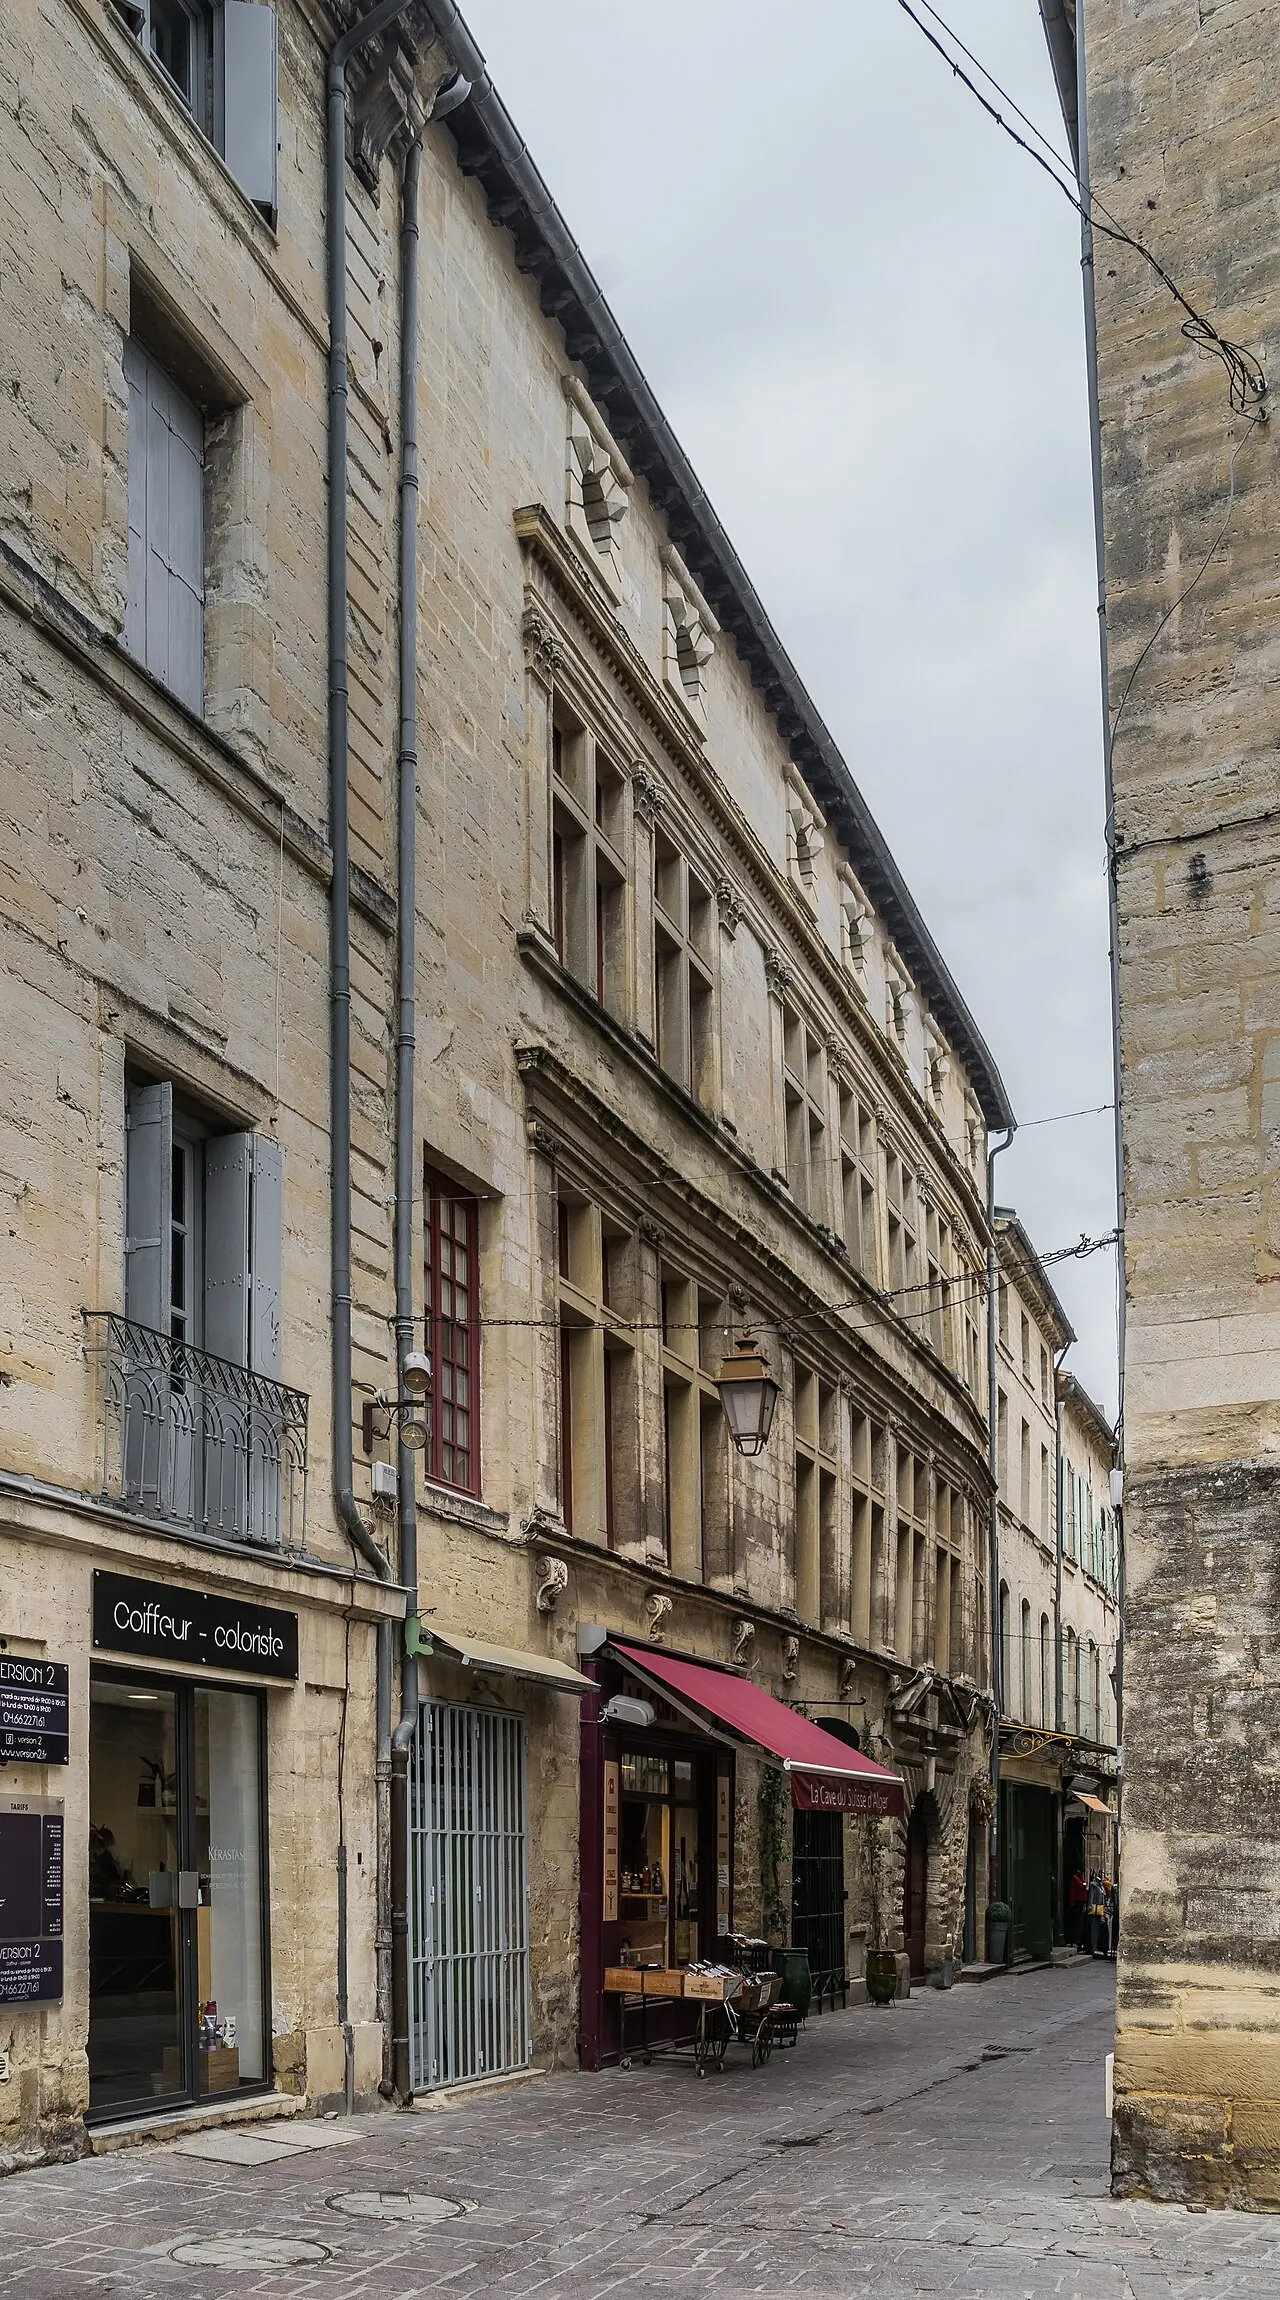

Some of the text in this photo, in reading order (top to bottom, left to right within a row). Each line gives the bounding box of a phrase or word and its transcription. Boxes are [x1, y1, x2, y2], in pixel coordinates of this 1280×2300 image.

[114, 1601, 192, 1641] Coiffeur
[214, 1621, 284, 1658] coloriste
[1, 1663, 55, 1686] ERSION 2
[18, 1735, 37, 1744] version
[38, 1736, 42, 1745] 2
[10, 1803, 28, 1811] TARIFS
[810, 1784, 889, 1814] La Cave du Suisse d'Alger
[34, 1943, 41, 1958] 2
